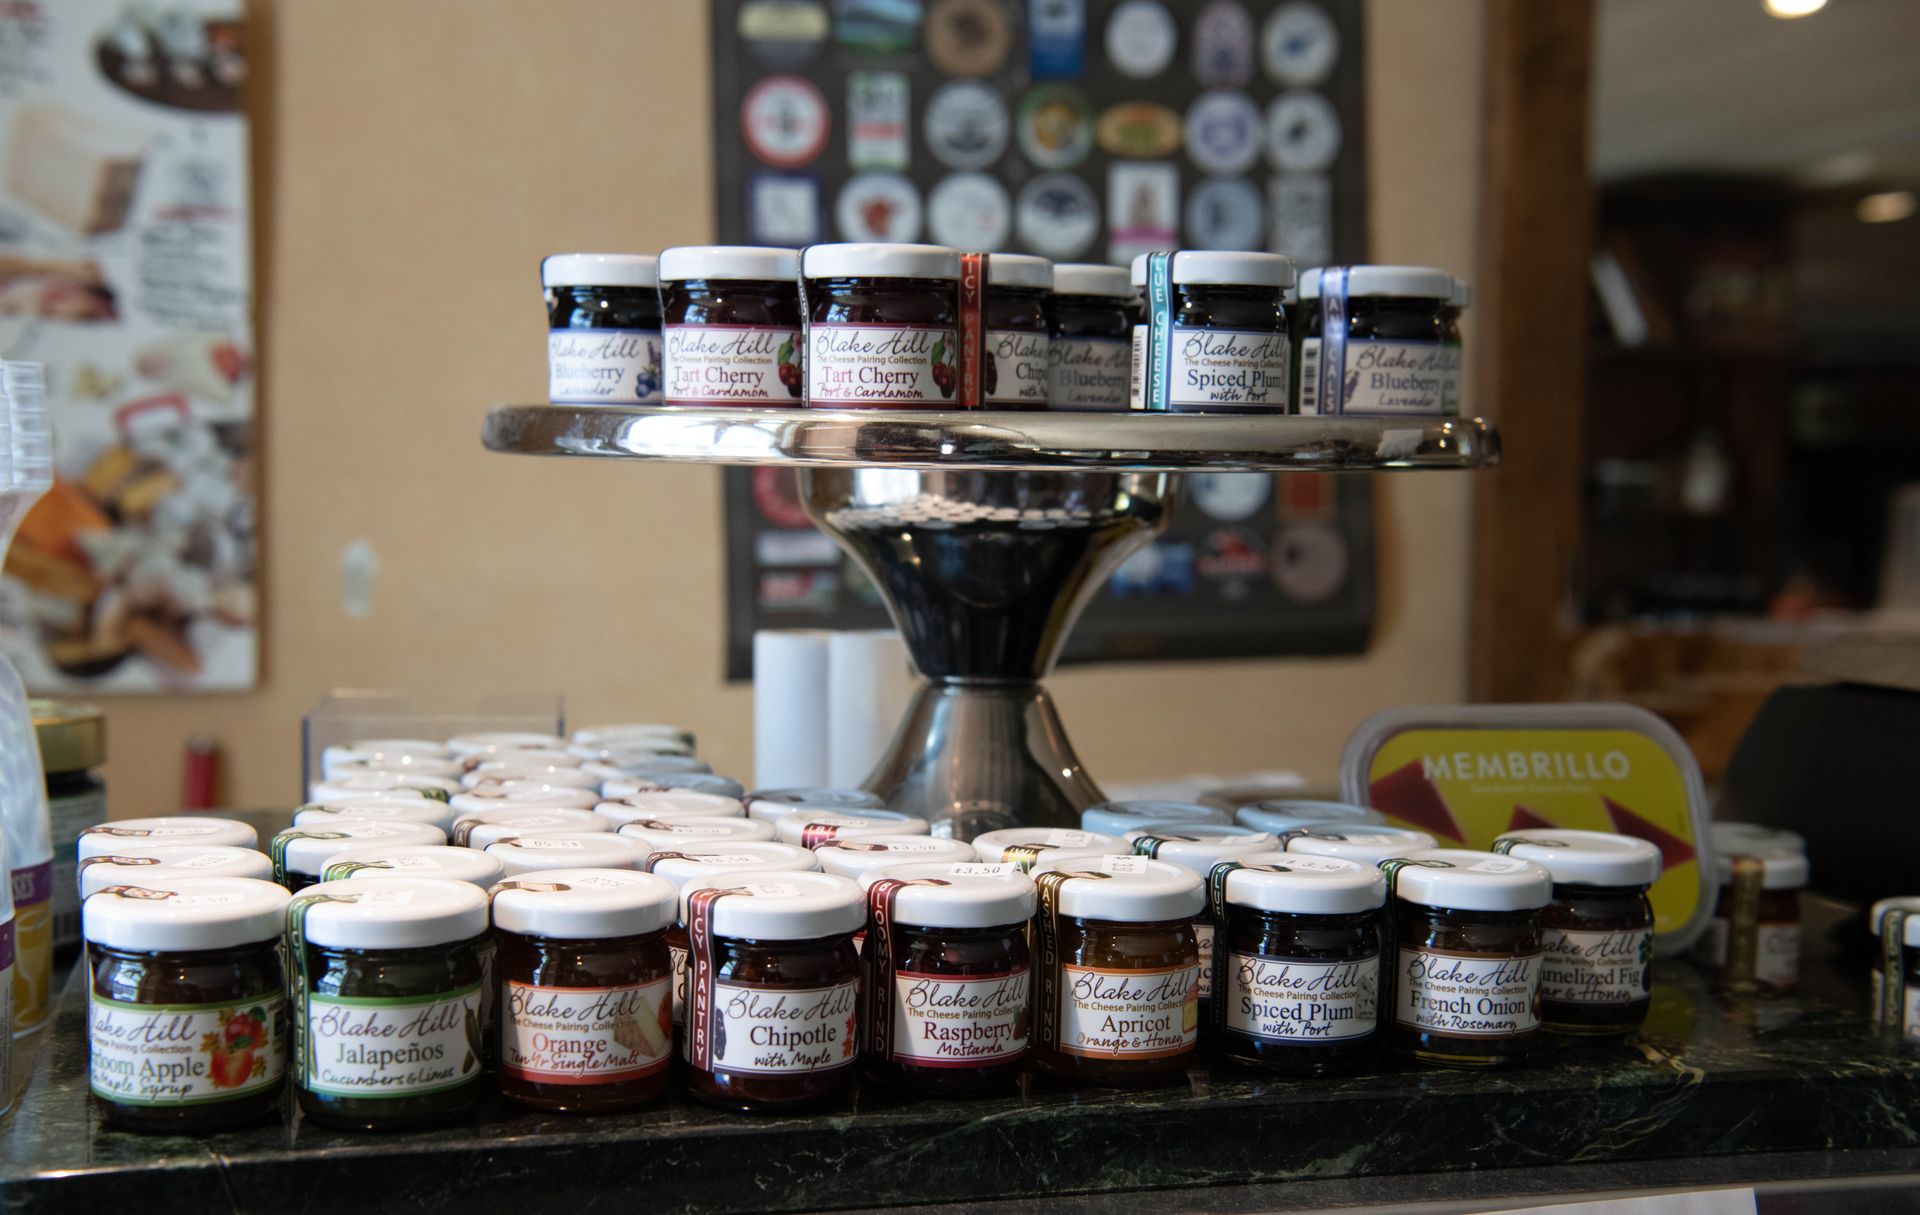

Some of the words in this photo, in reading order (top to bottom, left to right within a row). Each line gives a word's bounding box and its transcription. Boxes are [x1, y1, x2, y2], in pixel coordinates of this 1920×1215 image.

[589, 333, 640, 359] Hill
[668, 328, 719, 354] Blake
[721, 328, 775, 355] Hill
[816, 327, 875, 354] Blake
[875, 326, 930, 355] Hill
[1182, 331, 1249, 358] Blake
[679, 356, 702, 364] Cheese
[703, 356, 731, 365] Pairing
[733, 357, 773, 365] Collection
[817, 355, 828, 364] The
[829, 355, 855, 364] Cheese
[857, 355, 886, 366] Pairing
[888, 355, 927, 365] Collection
[964, 314, 976, 398] PANTRY
[1153, 312, 1165, 403] CHEESE
[1184, 358, 1198, 367] The
[1201, 358, 1231, 368] Cheese
[1233, 358, 1259, 369] Pairing
[1356, 344, 1417, 369] Blake
[556, 366, 626, 385] Blueberry
[674, 366, 700, 381] Tart
[704, 367, 764, 386] Cherry
[822, 366, 853, 382] Tart
[859, 366, 919, 388] Cherry
[1186, 369, 1247, 391] Spiced
[1251, 369, 1281, 387] Plum
[1370, 373, 1440, 394] Blueberry
[670, 382, 689, 397] Port
[692, 388, 698, 396] &
[701, 382, 769, 398] Cardamom
[818, 382, 841, 399] Port
[843, 388, 852, 398] &
[854, 382, 923, 399] Cardamom
[1210, 388, 1241, 402] with
[1244, 386, 1268, 402] Port
[1423, 751, 1630, 781] MEMBRILLO
[874, 883, 890, 972] BLOOMY
[1585, 930, 1636, 957] Hill
[1406, 953, 1478, 984] Blake
[1480, 957, 1530, 986] Hill
[1565, 957, 1595, 967] Pairing
[1597, 958, 1633, 966] Collection
[1071, 971, 1145, 1000] Blake
[1146, 968, 1191, 1001] Hill
[1236, 958, 1306, 988] Blake
[1308, 960, 1360, 991] Hill
[1619, 968, 1640, 987] Fig
[905, 979, 981, 1008] Blake
[982, 974, 1025, 1009] Hill
[1239, 984, 1252, 994] The
[1254, 987, 1285, 999] Cheese
[1286, 990, 1318, 1002] Pairing
[1320, 991, 1359, 1000] Collection
[1409, 978, 1423, 989] The
[1424, 980, 1457, 994] Cheese
[1458, 984, 1490, 996] Pairing
[1491, 984, 1528, 996] Collection
[1564, 987, 1575, 998] &
[508, 986, 577, 1019] Blake
[578, 987, 641, 1021] Hill
[695, 960, 706, 1061] PANTRY
[725, 989, 803, 1020] Blake
[804, 983, 852, 1021] Hill
[908, 1007, 924, 1018] The
[927, 1008, 960, 1020] Cheese
[962, 1008, 992, 1020] Pairing
[1042, 979, 1054, 1042] RIND
[1073, 1000, 1089, 1010] The
[1091, 1001, 1124, 1012] Cheese
[1126, 1001, 1156, 1013] Pairing
[1241, 996, 1302, 1020] Spiced
[1310, 1002, 1353, 1021] Plum
[1410, 990, 1472, 1015] French
[1476, 996, 1526, 1015] Onion
[128, 1012, 196, 1043] Hill
[318, 1006, 398, 1038] Blake
[399, 999, 460, 1038] Hill
[510, 1018, 521, 1027] The
[523, 1018, 553, 1031] Cheese
[555, 1021, 589, 1034] Pairing
[875, 987, 887, 1051] RIND
[1100, 1014, 1171, 1037] Apricot
[1262, 1021, 1297, 1035] with
[1302, 1020, 1332, 1036] Port
[1415, 1011, 1451, 1027] with
[1451, 1014, 1517, 1034] Rosemary
[532, 1033, 608, 1056] Orange
[750, 1023, 837, 1051] Chipotle
[923, 1020, 1014, 1045] Raspberry
[1076, 1032, 1130, 1054] Orange
[1131, 1037, 1141, 1048] &
[1142, 1032, 1184, 1048] Honey
[336, 1042, 444, 1069] Jalapeños
[936, 1034, 1004, 1057] Mostarda
[139, 1056, 205, 1084] Apple
[510, 1048, 530, 1065] Ten
[550, 1051, 602, 1076] Single
[603, 1049, 641, 1067] Malt
[754, 1053, 789, 1068] with
[790, 1048, 832, 1072] Maple
[139, 1078, 193, 1101] Syrup
[406, 1074, 417, 1085] &
